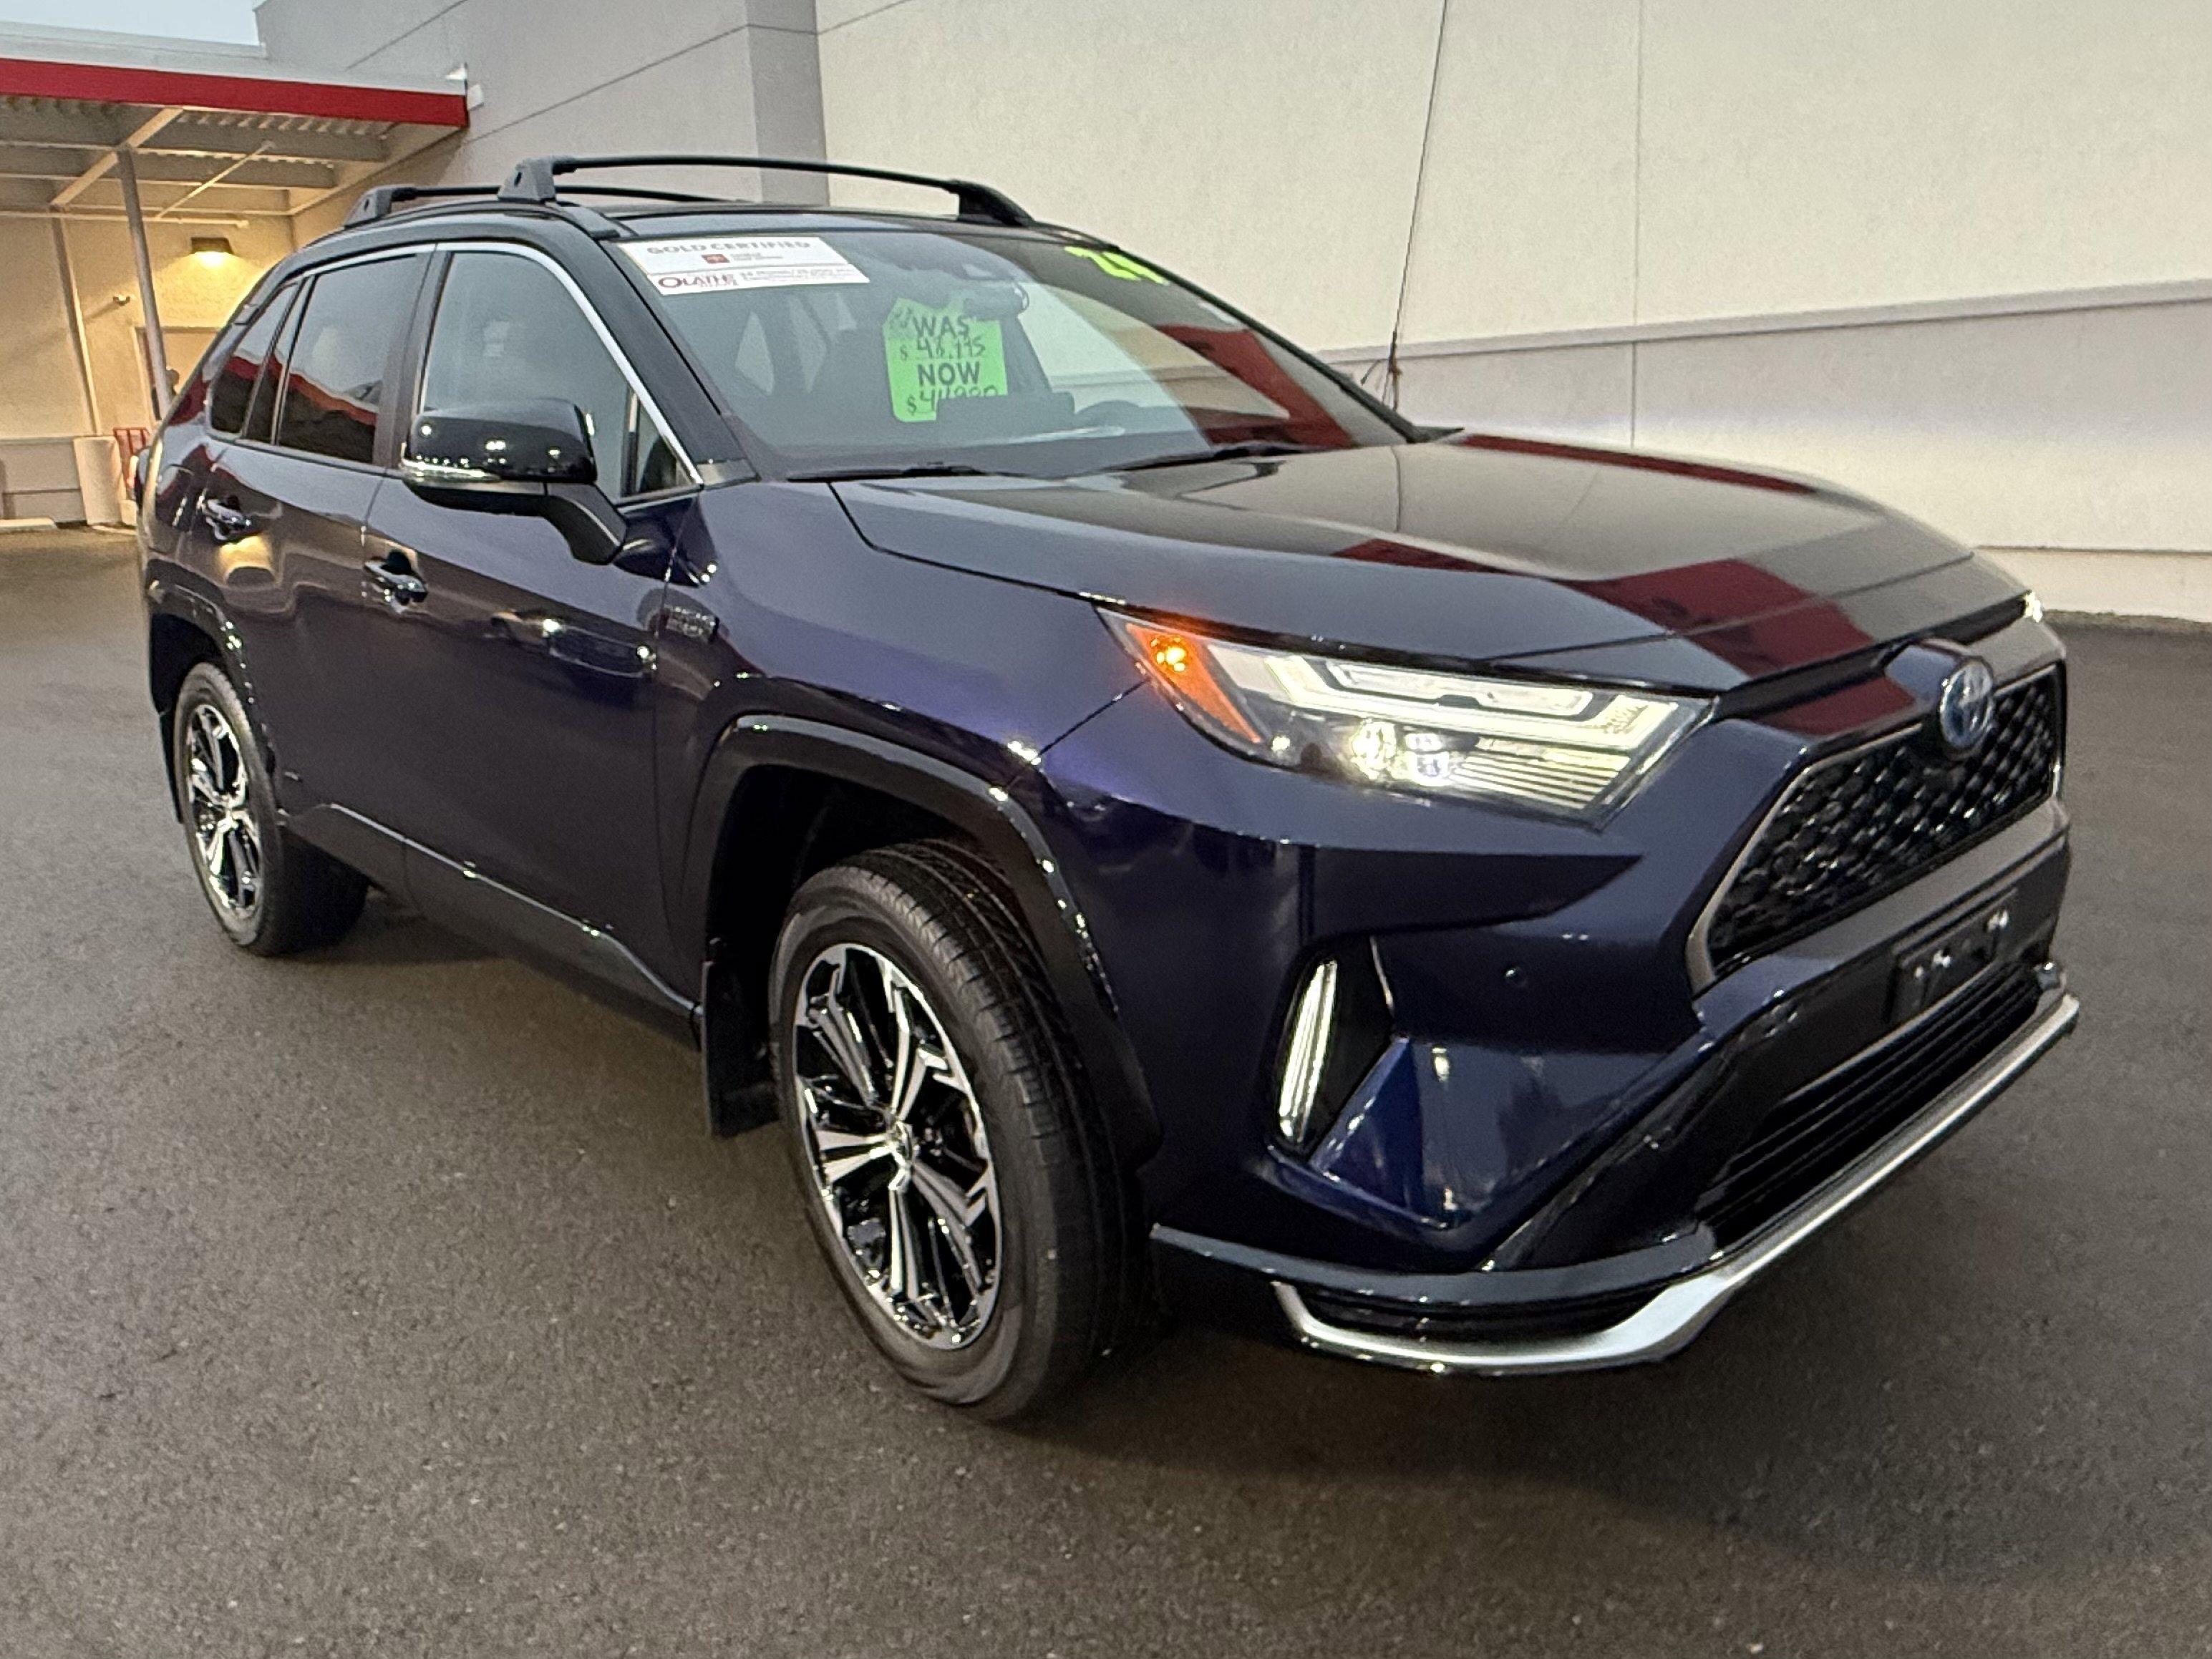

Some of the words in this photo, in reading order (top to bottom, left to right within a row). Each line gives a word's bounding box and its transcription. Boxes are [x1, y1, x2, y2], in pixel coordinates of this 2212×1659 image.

[647, 244, 707, 254] GOLD
[710, 240, 810, 250] CERTIFIED
[912, 316, 970, 339] WAS
[917, 361, 980, 386] NOW
